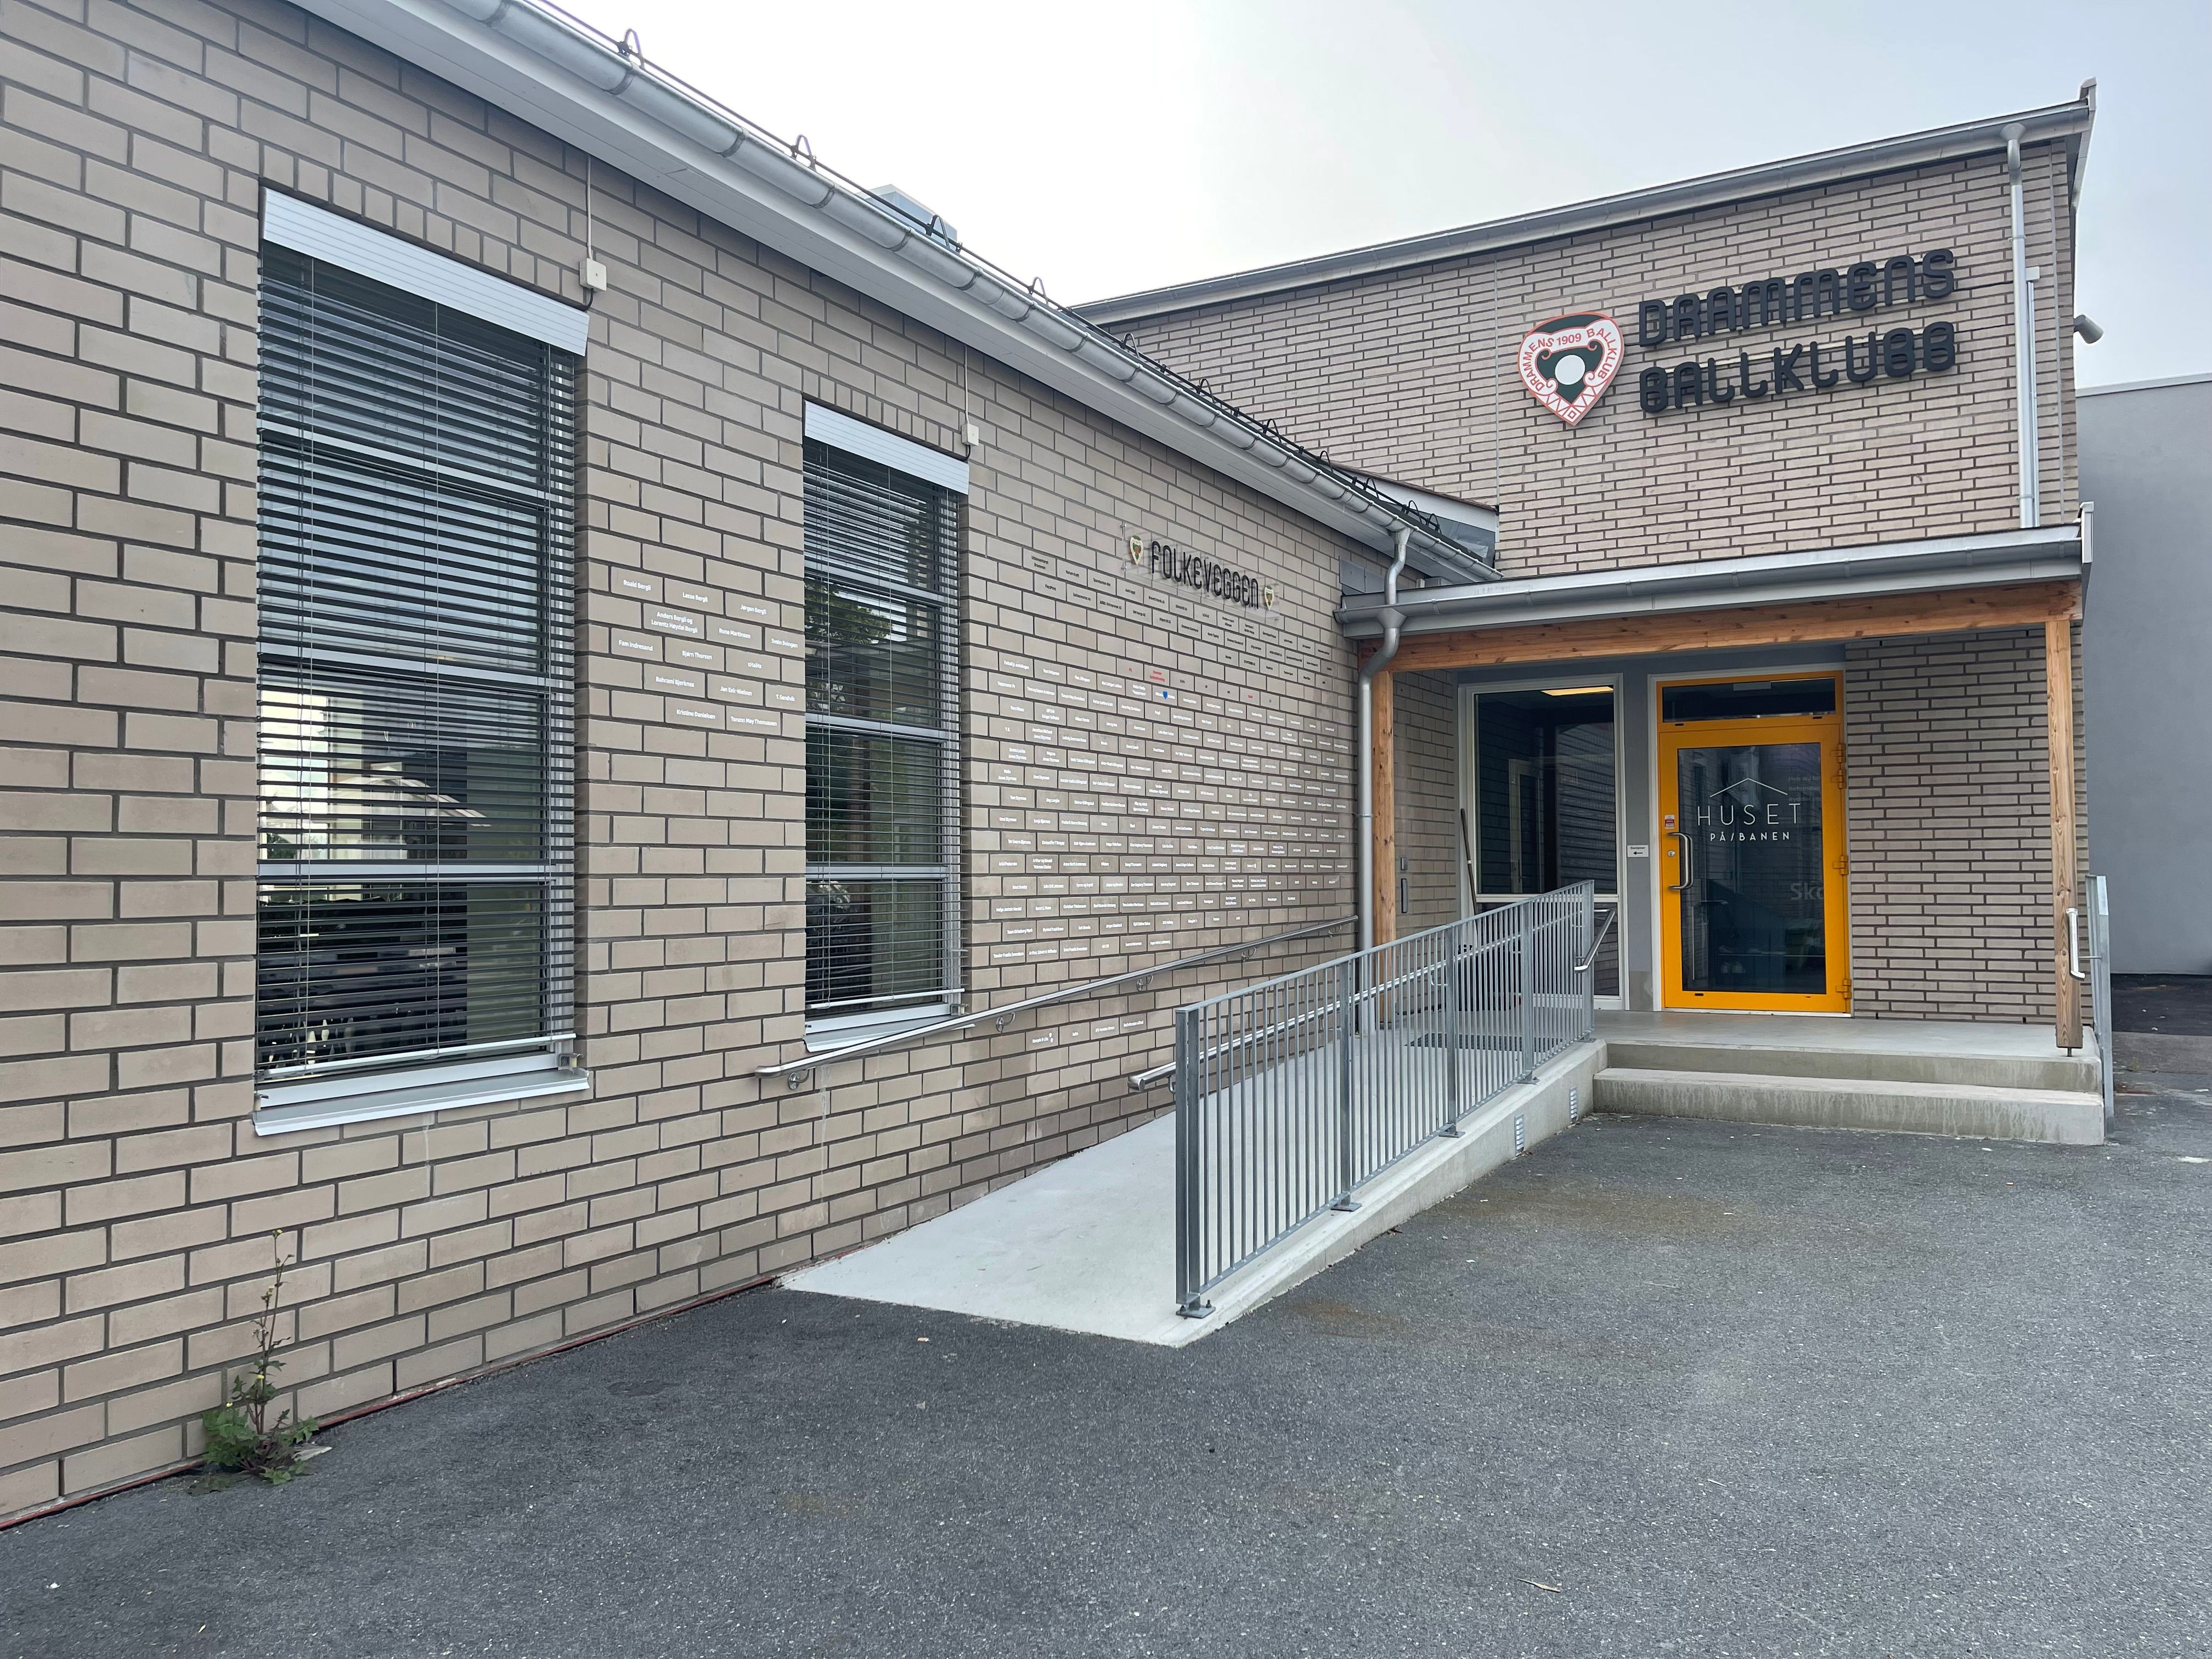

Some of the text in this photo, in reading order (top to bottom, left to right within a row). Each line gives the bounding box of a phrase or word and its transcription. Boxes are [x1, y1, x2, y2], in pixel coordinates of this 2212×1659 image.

[1639, 249, 1955, 347] DRAMMENS
[1523, 328, 1617, 392] DRAMMENS 1909 BALLKLUB
[1640, 322, 1955, 413] BALLKLUBB
[1152, 541, 1259, 609] FOLKEVEGGEN
[1697, 803, 1801, 826] HUSET
